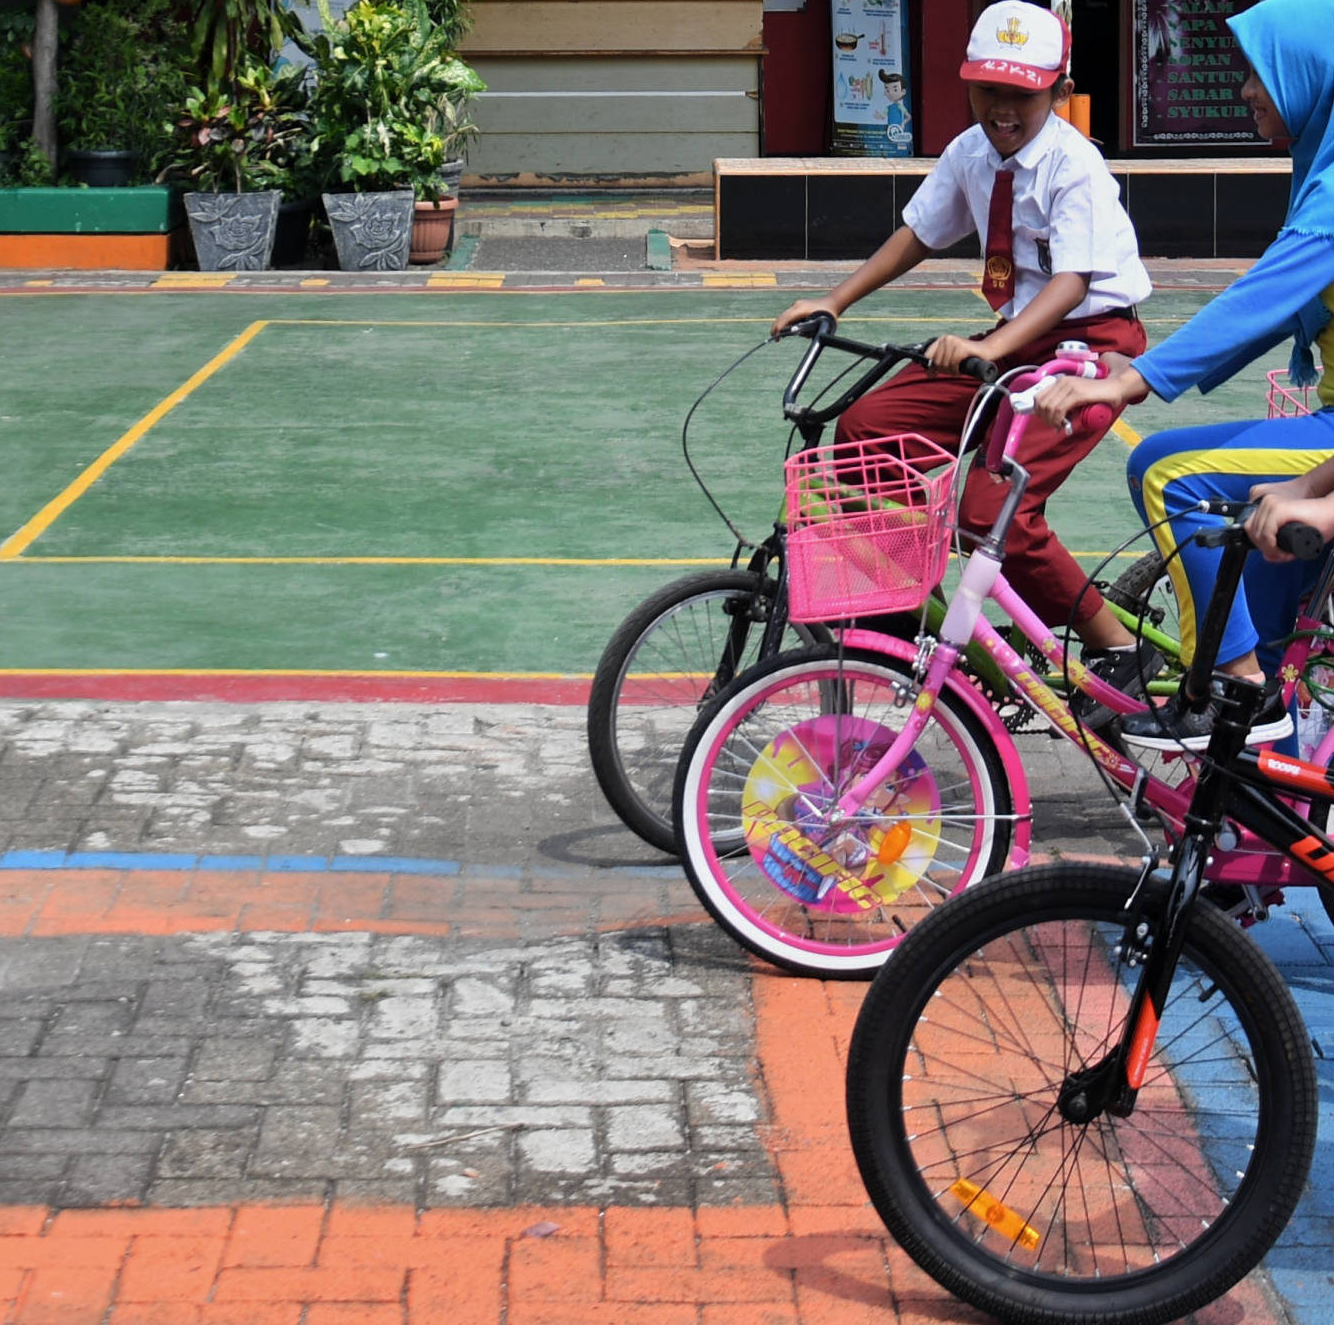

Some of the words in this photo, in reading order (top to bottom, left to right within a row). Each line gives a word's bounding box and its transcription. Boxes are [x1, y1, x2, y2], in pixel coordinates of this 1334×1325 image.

[1168, 54, 1231, 66] SOPAN
[1168, 70, 1245, 83] SANTUN
[1168, 88, 1234, 101] SABAR
[1168, 105, 1248, 118] SYUKUR
